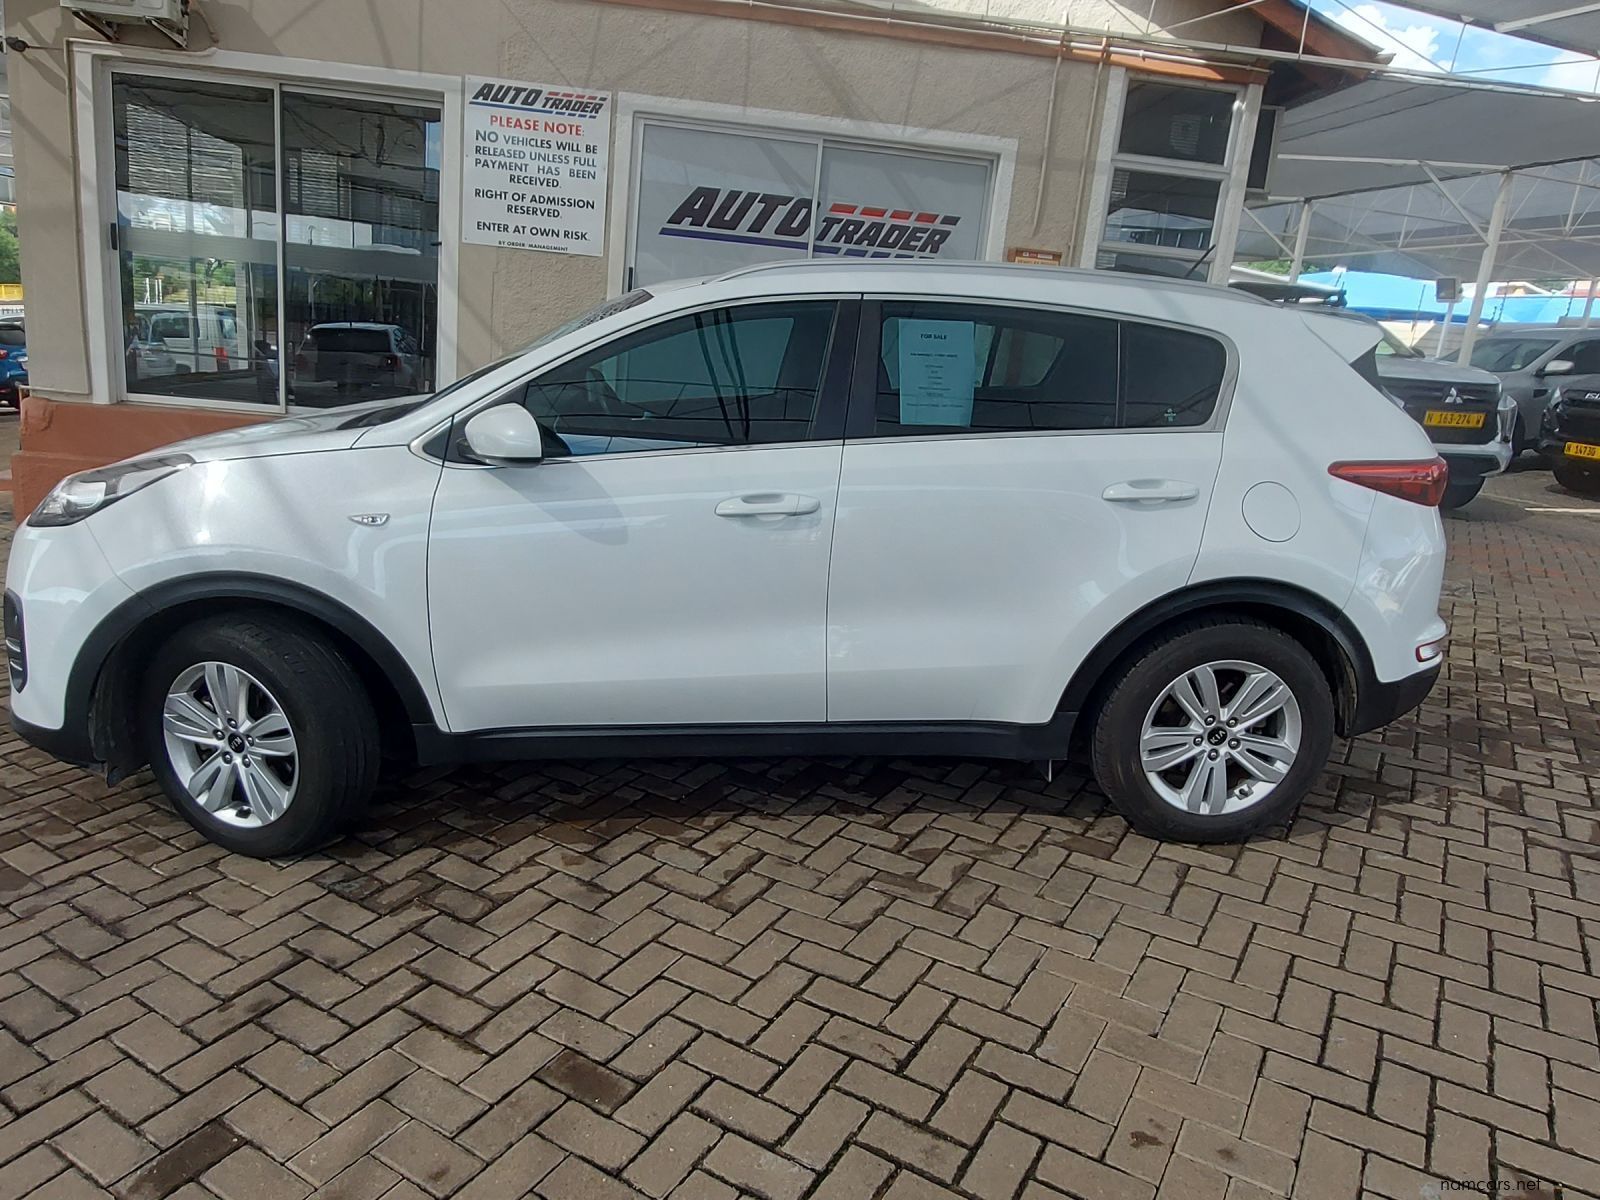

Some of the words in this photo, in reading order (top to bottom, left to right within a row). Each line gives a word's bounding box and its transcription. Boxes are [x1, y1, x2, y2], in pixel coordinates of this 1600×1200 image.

[472, 83, 544, 106] AUTO
[542, 96, 604, 114] TRADER
[490, 115, 539, 131] PLEASE
[544, 121, 585, 136] NOTE:
[475, 130, 498, 143] NO
[503, 135, 552, 149] VEHICLES
[556, 141, 581, 153] WILL
[586, 144, 598, 154] BE
[475, 145, 526, 160] RELEASED
[529, 151, 570, 164] UNLESS
[573, 156, 597, 167] FULL
[475, 158, 529, 173] PAYMENT
[537, 166, 561, 176] HAS
[569, 169, 596, 180] BEEN
[474, 188, 508, 201] RIGHT
[511, 192, 527, 202] OF
[529, 194, 595, 209] ADMISSION
[476, 221, 509, 233] ENTER
[512, 225, 527, 235] AT
[529, 227, 560, 238] OWN
[666, 186, 821, 237] AUTO
[816, 216, 952, 254] TRADER
[1426, 412, 1432, 424] N
[1475, 414, 1482, 424] W
